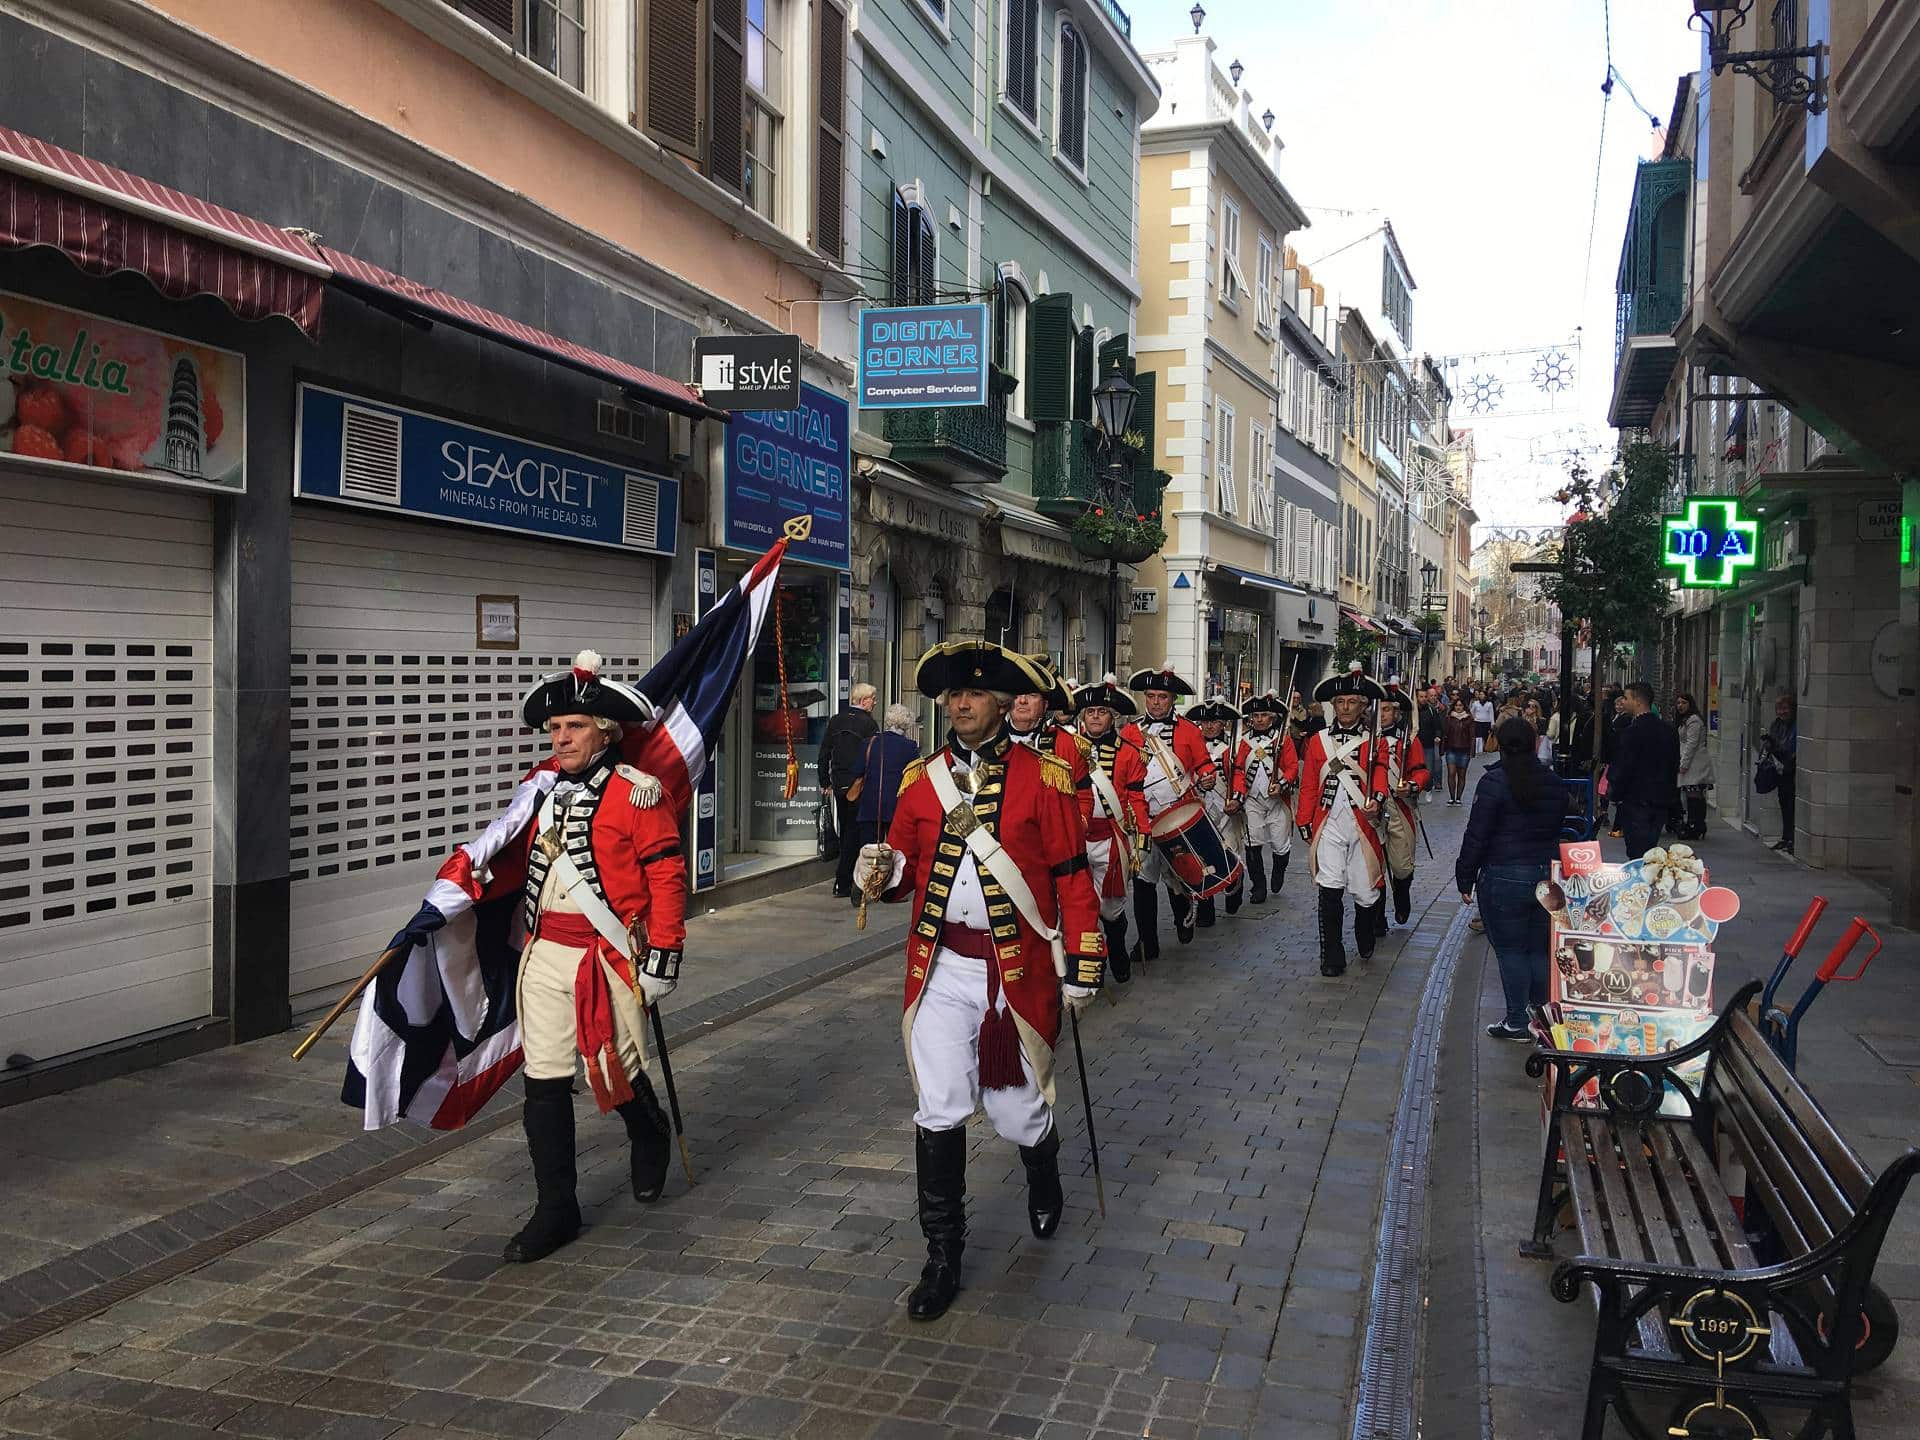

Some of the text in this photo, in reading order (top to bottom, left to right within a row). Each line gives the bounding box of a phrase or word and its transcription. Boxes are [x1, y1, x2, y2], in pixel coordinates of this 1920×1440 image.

[872, 319, 972, 342] DIGITAL
[866, 344, 978, 368] CORNER
[866, 384, 977, 397] Computer Services
[736, 432, 843, 502] CORNER
[439, 487, 598, 529] MINERALS FROM THE DEAD SEA
[1716, 529, 1746, 558] A
[1589, 871, 1632, 892] Cornetto
[1610, 973, 1625, 987] M
[1699, 1318, 1738, 1334] 1997
